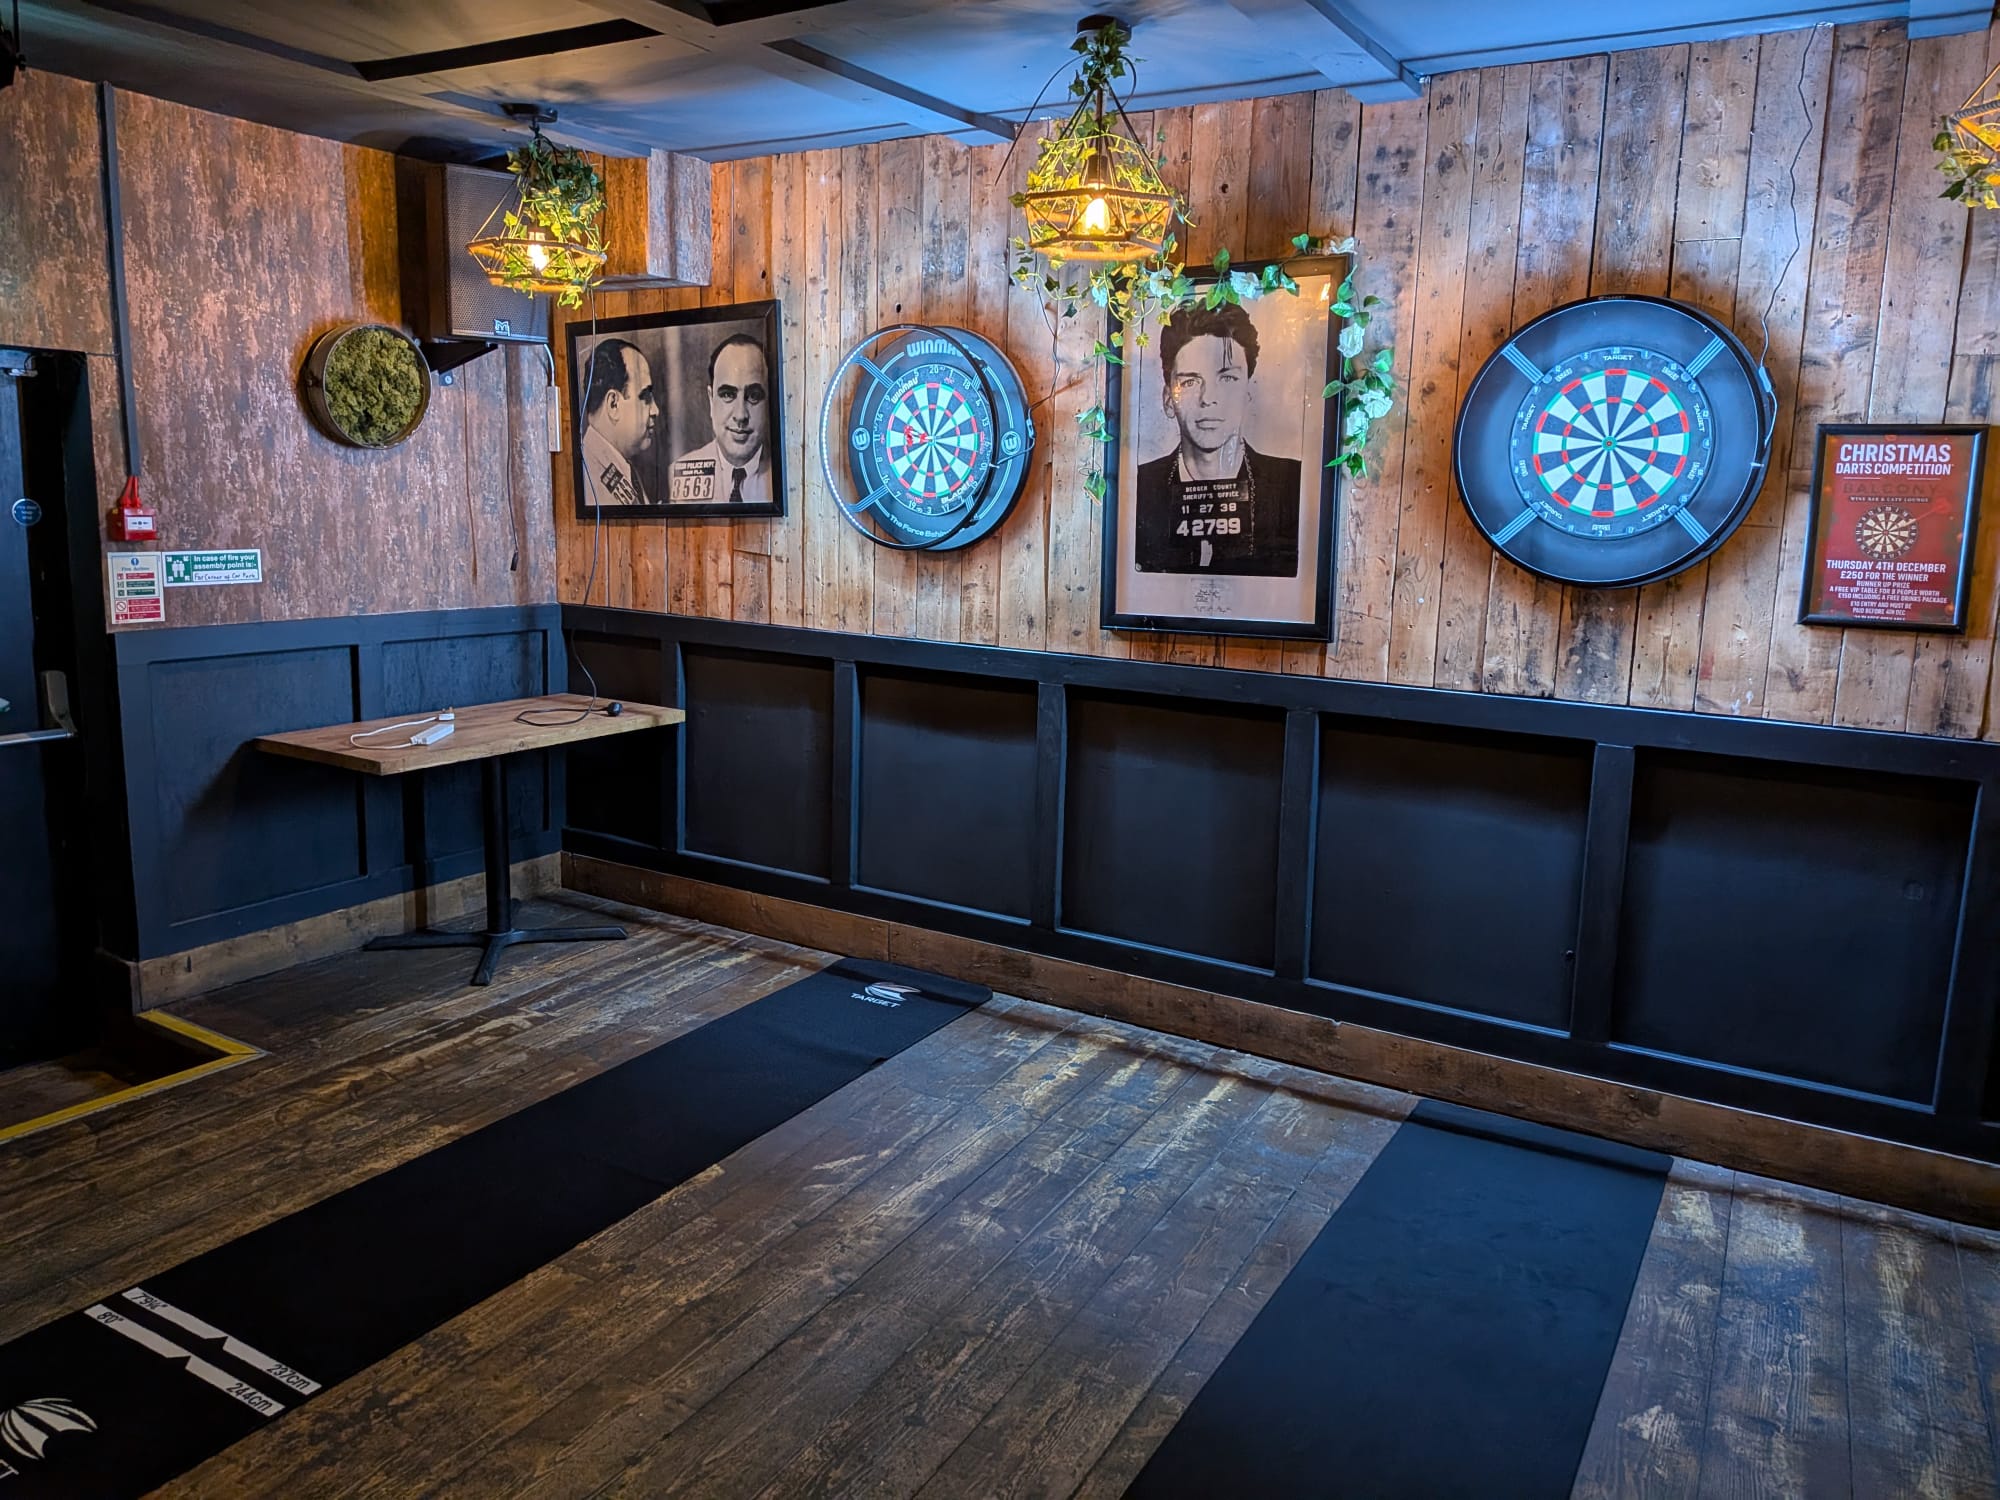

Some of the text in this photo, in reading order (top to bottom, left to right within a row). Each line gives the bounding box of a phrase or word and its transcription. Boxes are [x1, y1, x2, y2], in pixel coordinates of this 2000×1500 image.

[1840, 443, 1951, 462] CHRISTMAS
[1835, 462, 1952, 476] DARTS COMPETITION
[672, 476, 711, 499] 3563
[1213, 483, 1237, 491] COUNTY
[1843, 483, 1938, 494] BALCONY
[1181, 502, 1237, 514] 11 27 38
[890, 514, 903, 527] The
[902, 523, 924, 536] Force
[1176, 517, 1241, 537] 42799
[194, 562, 225, 570] assembly
[227, 562, 245, 570] point
[1826, 559, 1946, 573] THURSDAY 4TH DECEMBER
[1840, 570, 1929, 582] £250 FOR THE WINNER
[850, 992, 901, 1008] TARGET
[266, 1363, 310, 1391] 237cm
[226, 1382, 272, 1413] 244cm
